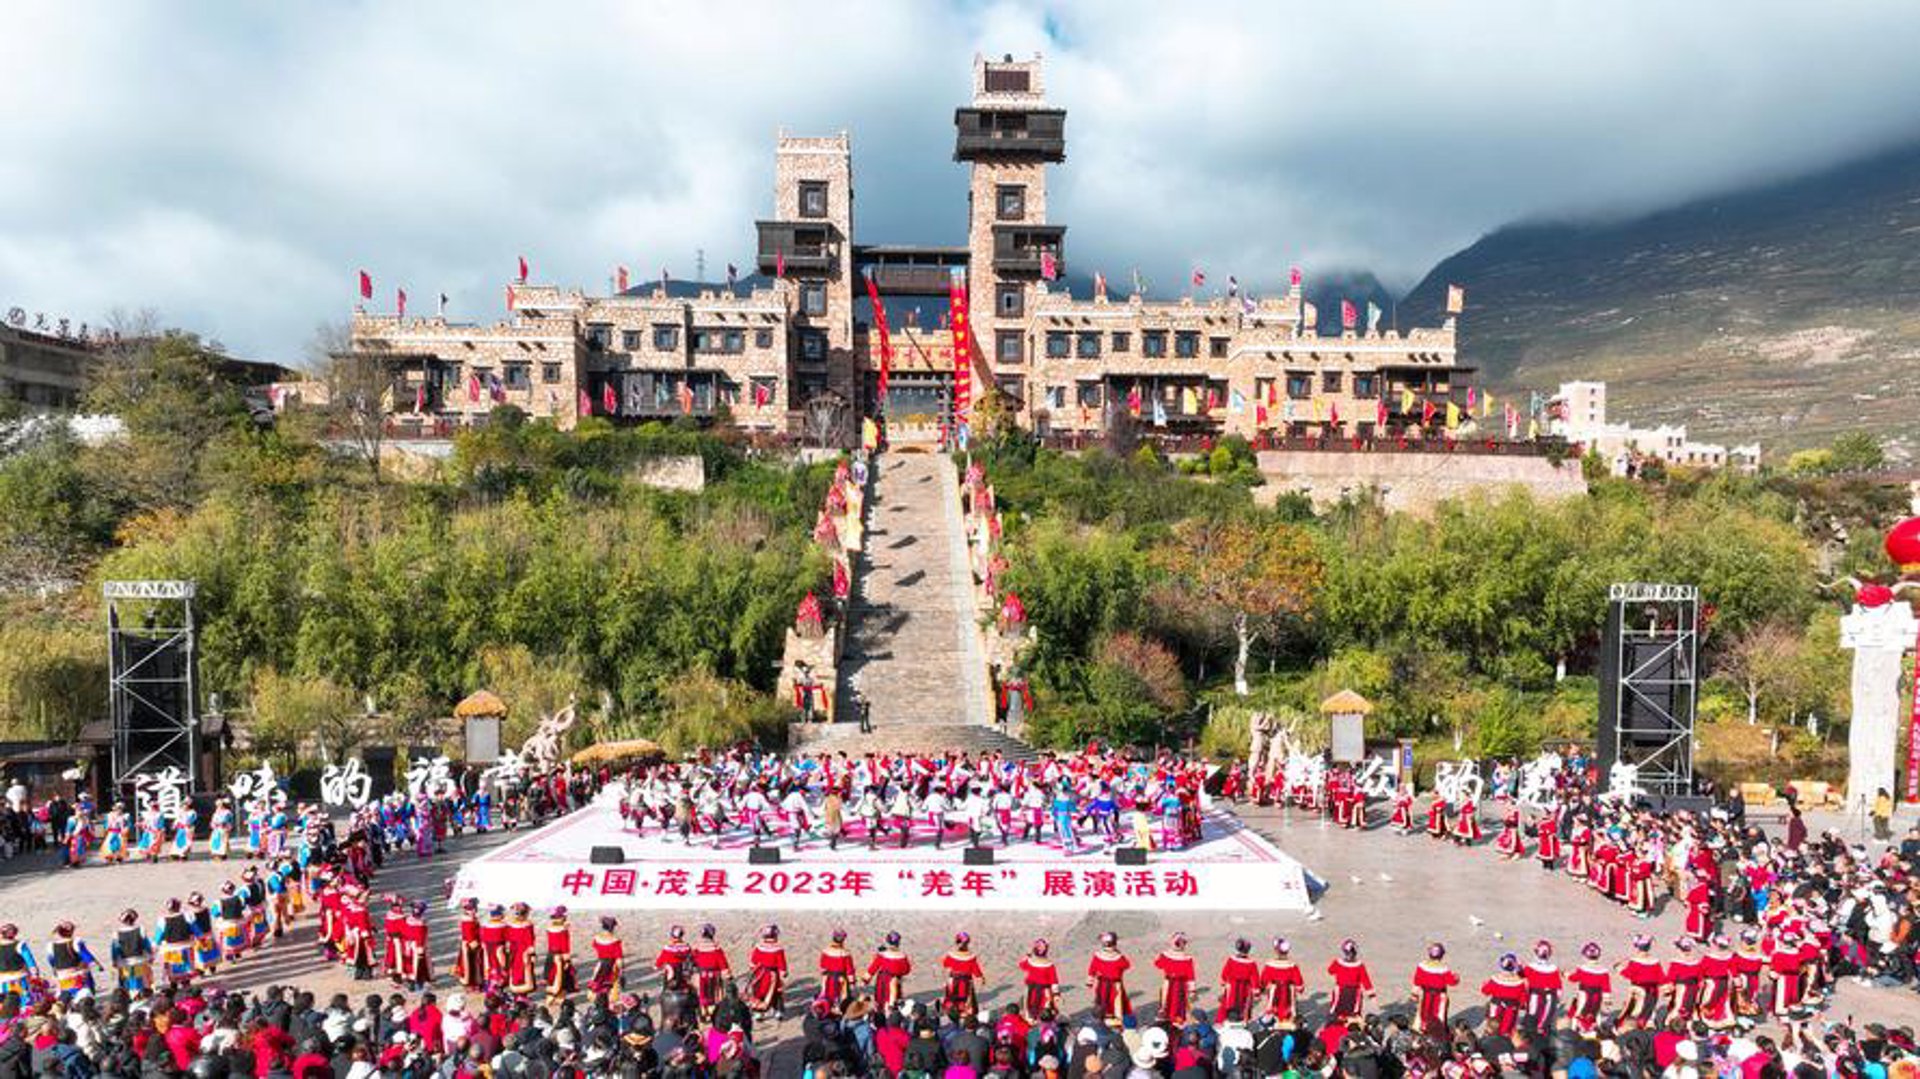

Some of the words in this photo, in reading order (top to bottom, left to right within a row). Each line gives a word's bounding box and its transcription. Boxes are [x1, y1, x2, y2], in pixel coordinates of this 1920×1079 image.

[561, 868, 730, 896] 中国·茂县
[743, 869, 872, 896] 2023年
[897, 869, 1016, 897] “羌年”
[1043, 868, 1198, 897] 展演活动
